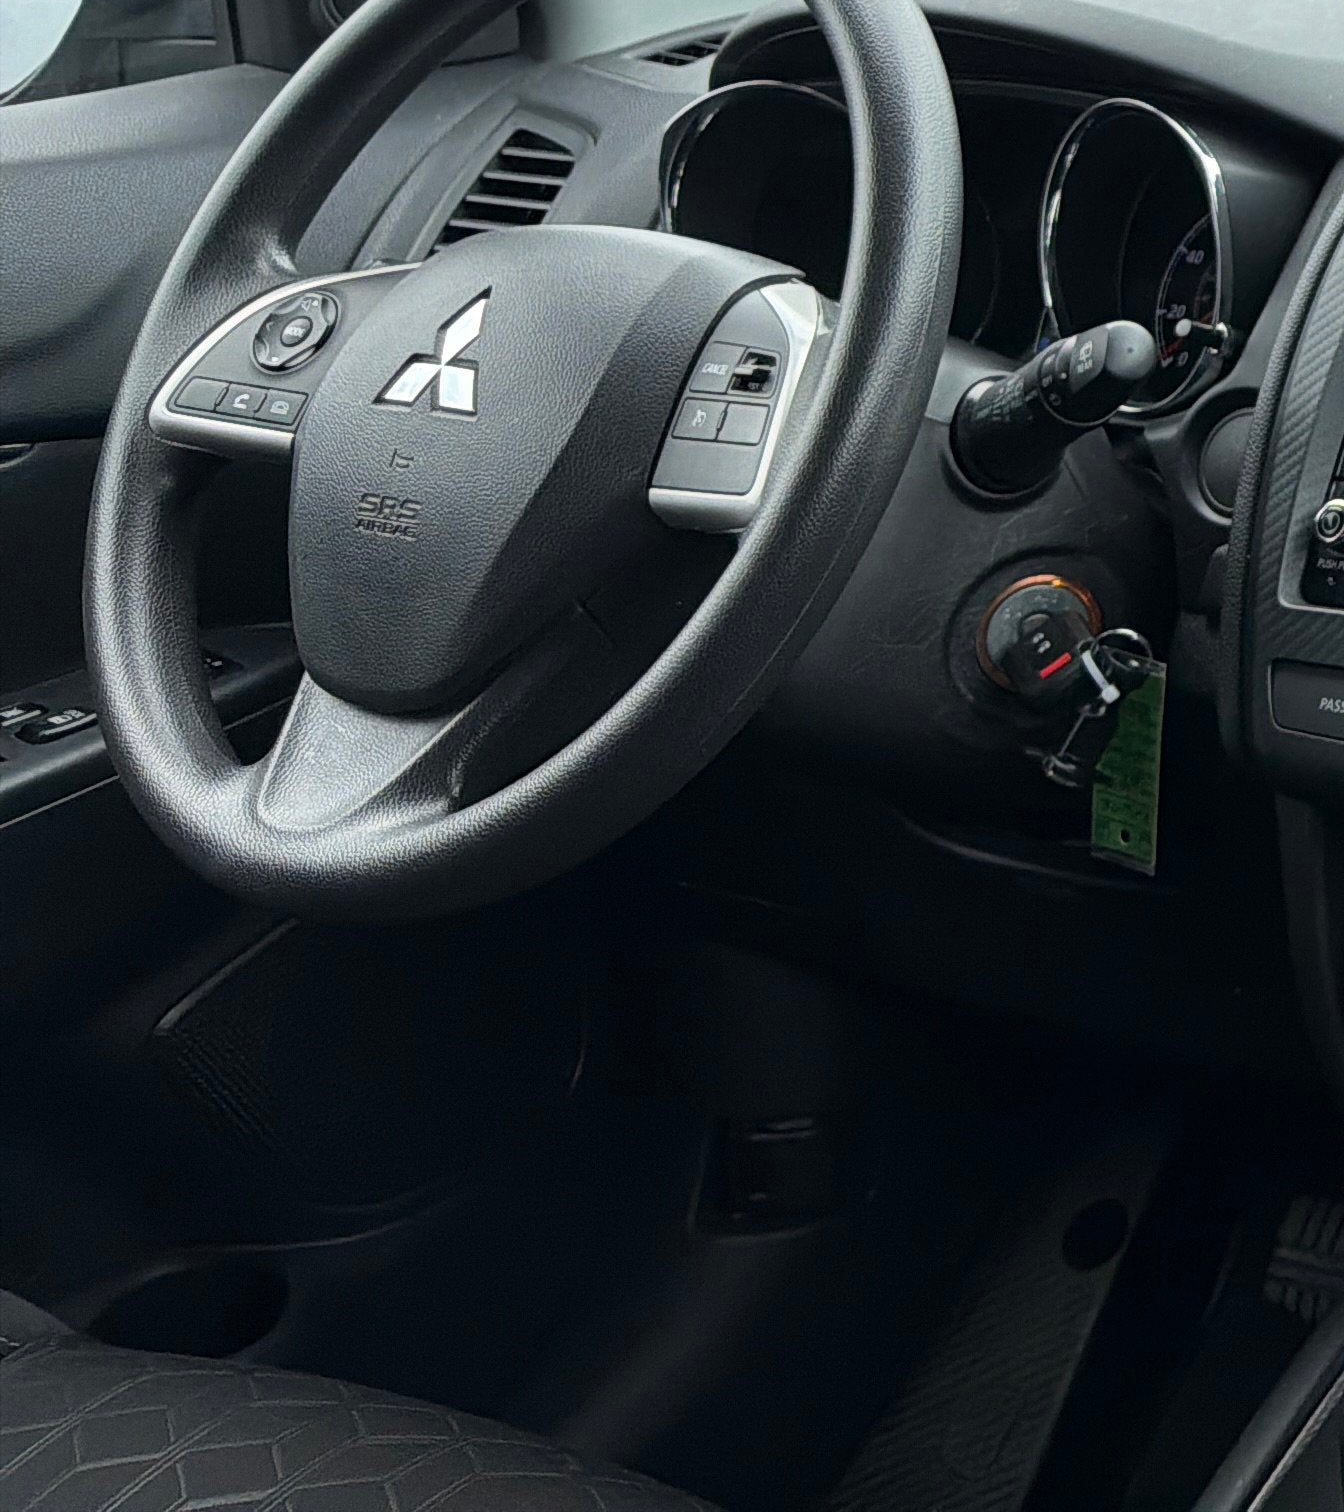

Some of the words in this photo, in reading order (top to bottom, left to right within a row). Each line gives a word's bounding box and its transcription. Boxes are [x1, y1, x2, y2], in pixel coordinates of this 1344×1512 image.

[1185, 249, 1205, 265] 40
[1166, 304, 1187, 319] 20
[358, 492, 422, 519] SRS
[1316, 558, 1338, 569] PUSH
